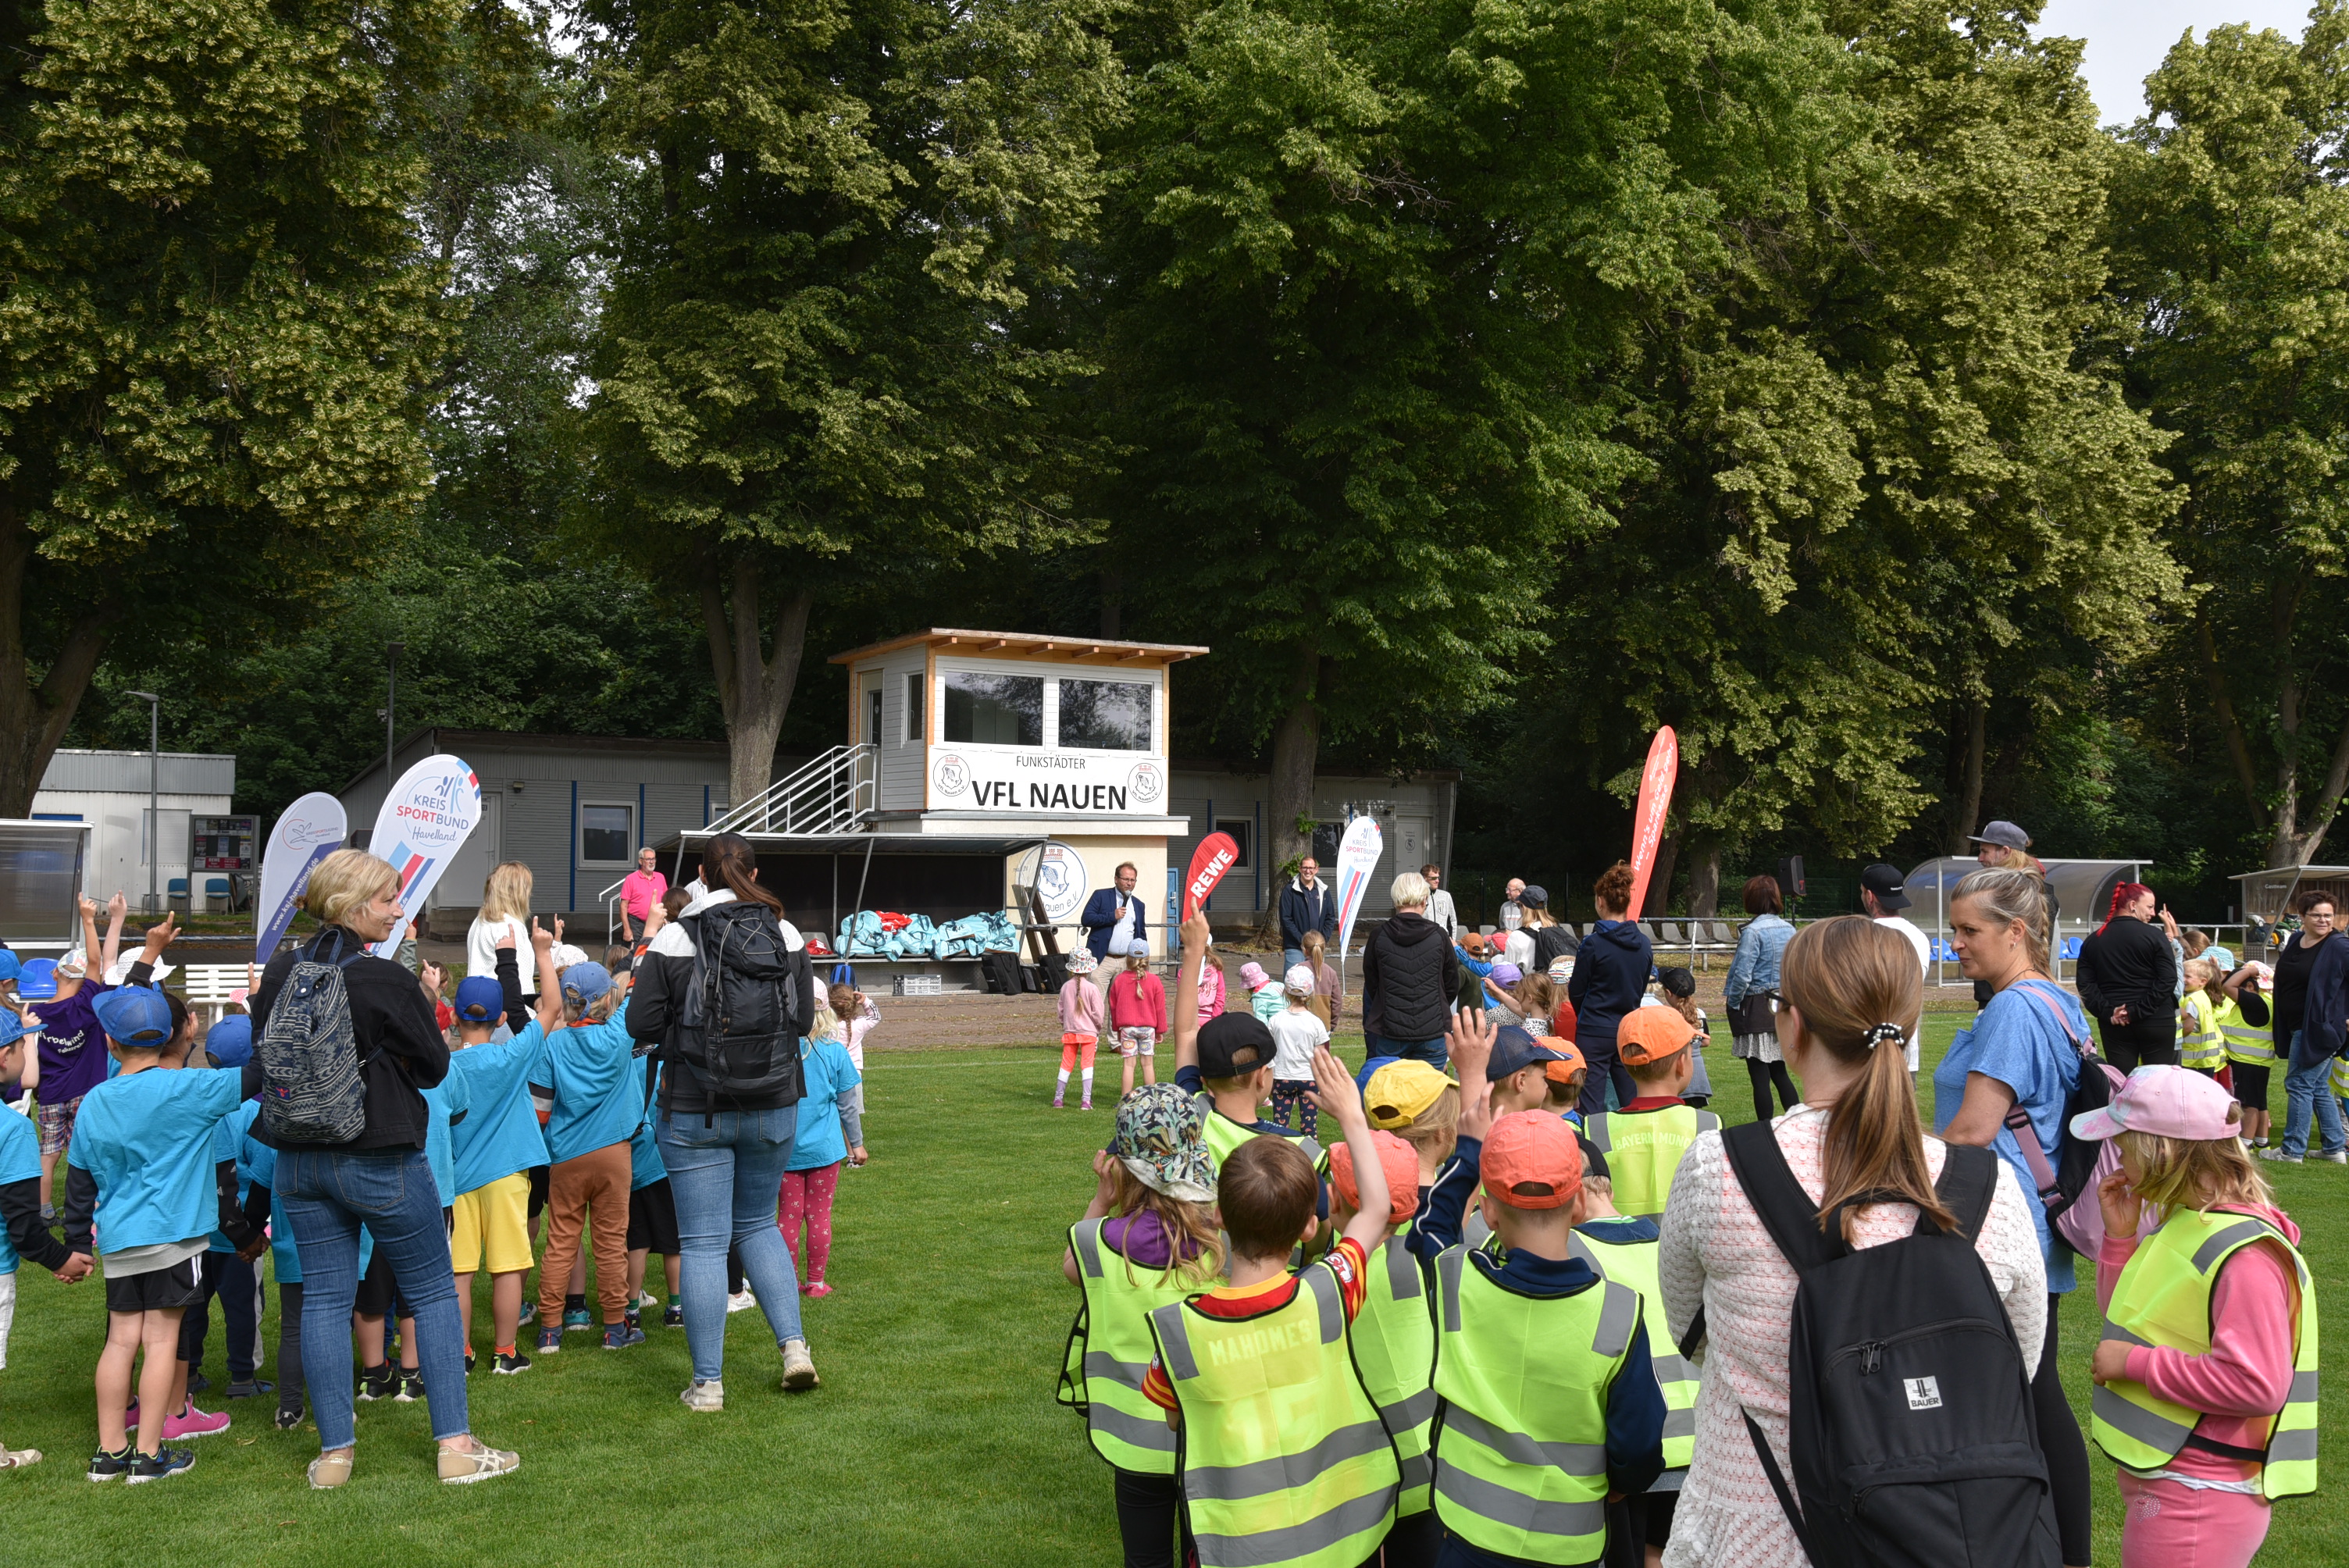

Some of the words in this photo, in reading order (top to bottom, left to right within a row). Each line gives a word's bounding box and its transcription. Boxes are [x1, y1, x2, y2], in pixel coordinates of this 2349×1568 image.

[1016, 754, 1085, 769] FUNKSTÄDTER
[413, 794, 446, 811] KREIS
[971, 781, 1021, 807] VFL
[1030, 782, 1127, 811] NAUEN
[1634, 824, 1651, 871] Wenn's
[1649, 804, 1656, 824] um
[1655, 770, 1664, 800] Geld
[1663, 743, 1674, 772] geht
[396, 805, 469, 830] SPORTBUND
[1649, 784, 1668, 847] Sparkasse
[412, 825, 458, 842] Havelland
[1346, 846, 1378, 856] SPORTBUND
[1190, 848, 1233, 899] REWE
[271, 857, 319, 931] www.ksj-havelland.de
[1043, 901, 1064, 912] auen
[1615, 1131, 1655, 1151] BAYERN
[1208, 1319, 1313, 1367] MAHOMES
[1911, 1397, 1939, 1407] BAUER
